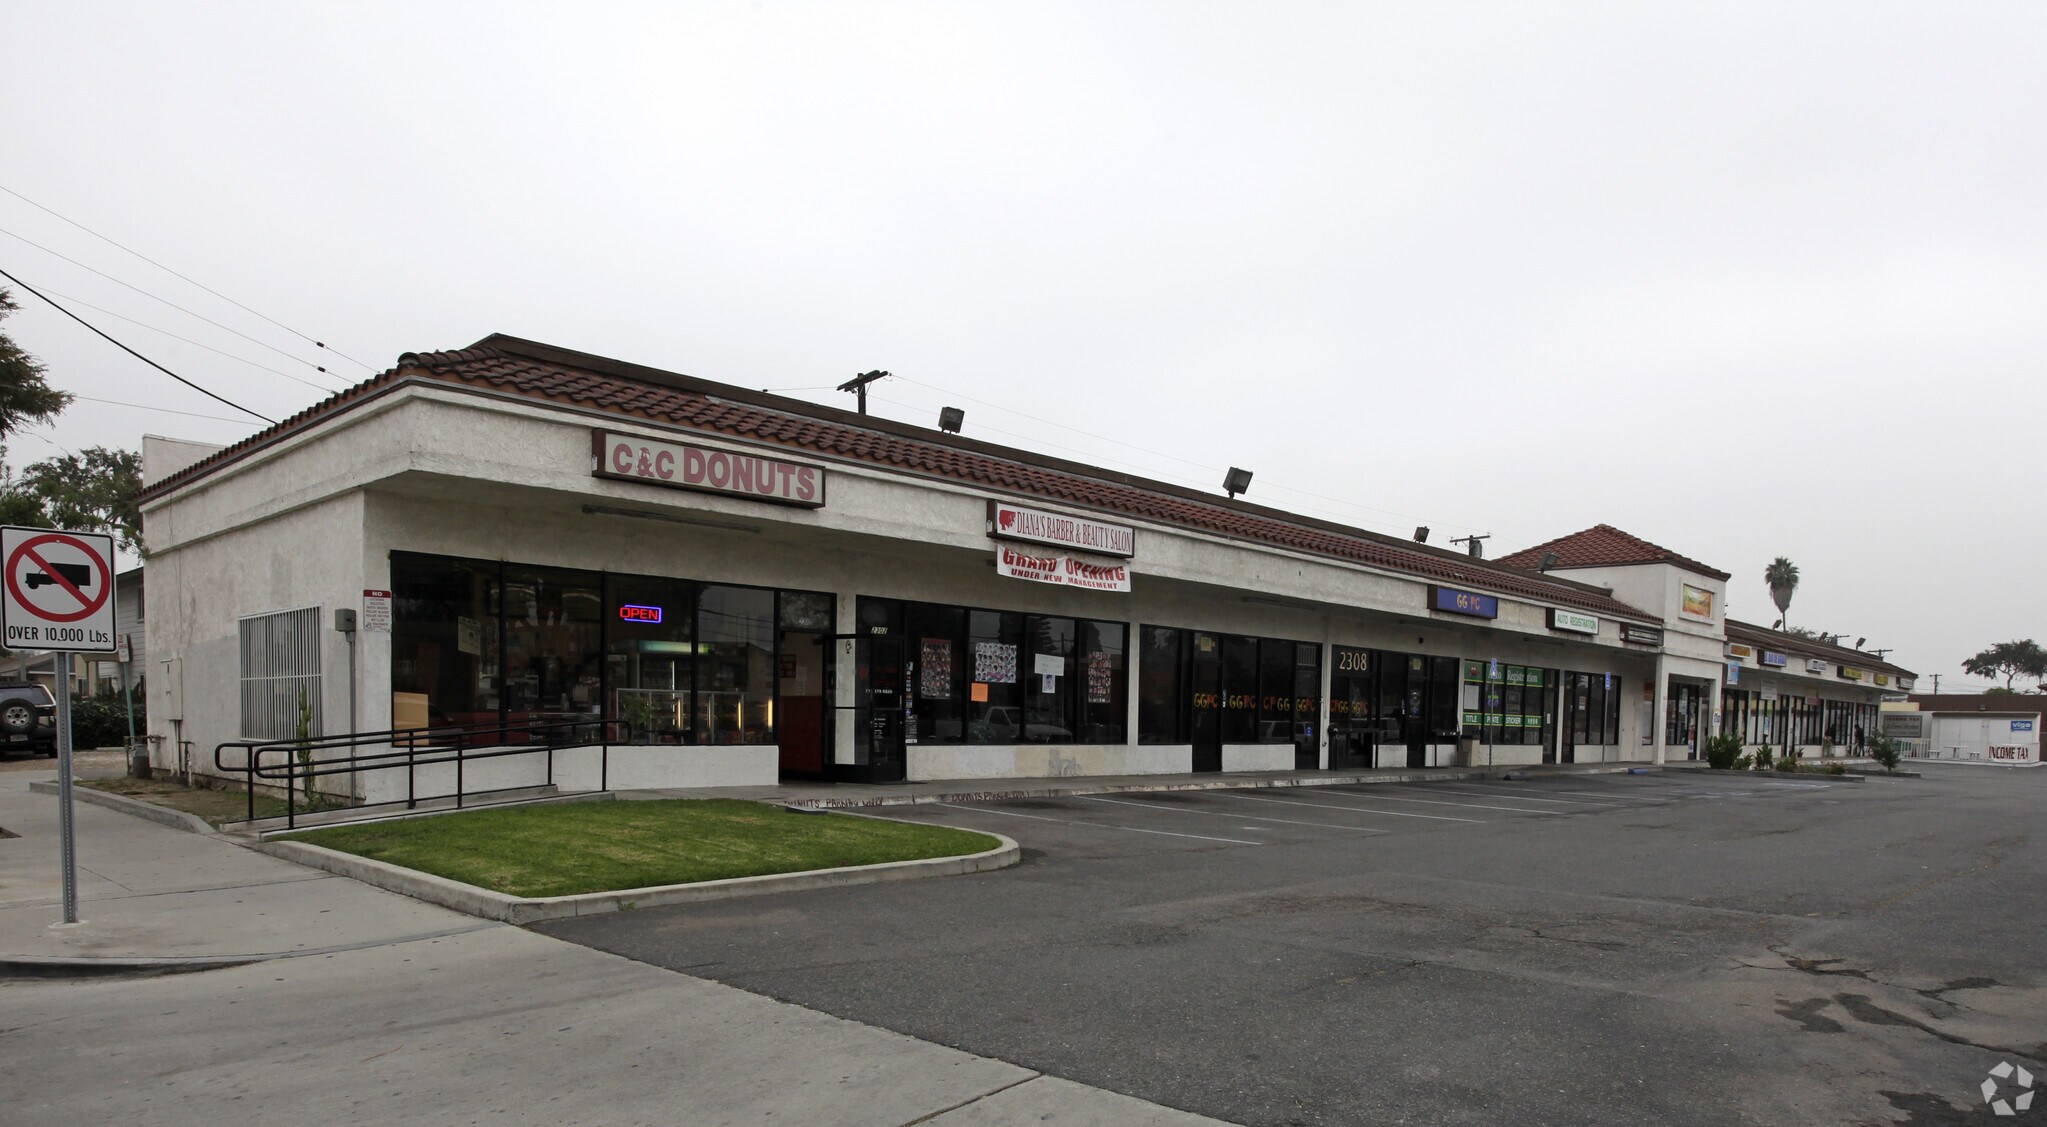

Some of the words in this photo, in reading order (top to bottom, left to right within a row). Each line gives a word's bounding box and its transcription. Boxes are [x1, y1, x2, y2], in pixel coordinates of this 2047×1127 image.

[612, 443, 675, 480] C&C
[683, 447, 816, 500] DONUTS
[1017, 511, 1046, 539] DIANA'S
[1047, 516, 1075, 543] BARBER
[1075, 523, 1081, 544] &
[1082, 523, 1110, 549] BEAUTY
[1110, 530, 1132, 553] SALON
[1002, 547, 1058, 573] GRAND
[1065, 557, 1126, 582] OPENING
[1011, 568, 1040, 580] UNDER
[1043, 574, 1063, 583] NEW
[1067, 576, 1118, 590] MANAGEMENT
[620, 606, 659, 621] OPEN
[1556, 613, 1569, 625] AUTO
[8, 625, 39, 641] OVER
[89, 629, 111, 643] Lbs.
[1339, 651, 1367, 671] 2308
[1465, 715, 1478, 723] TITLE
[1988, 745, 2015, 760] INCOME
[2017, 746, 2029, 760] TAX
